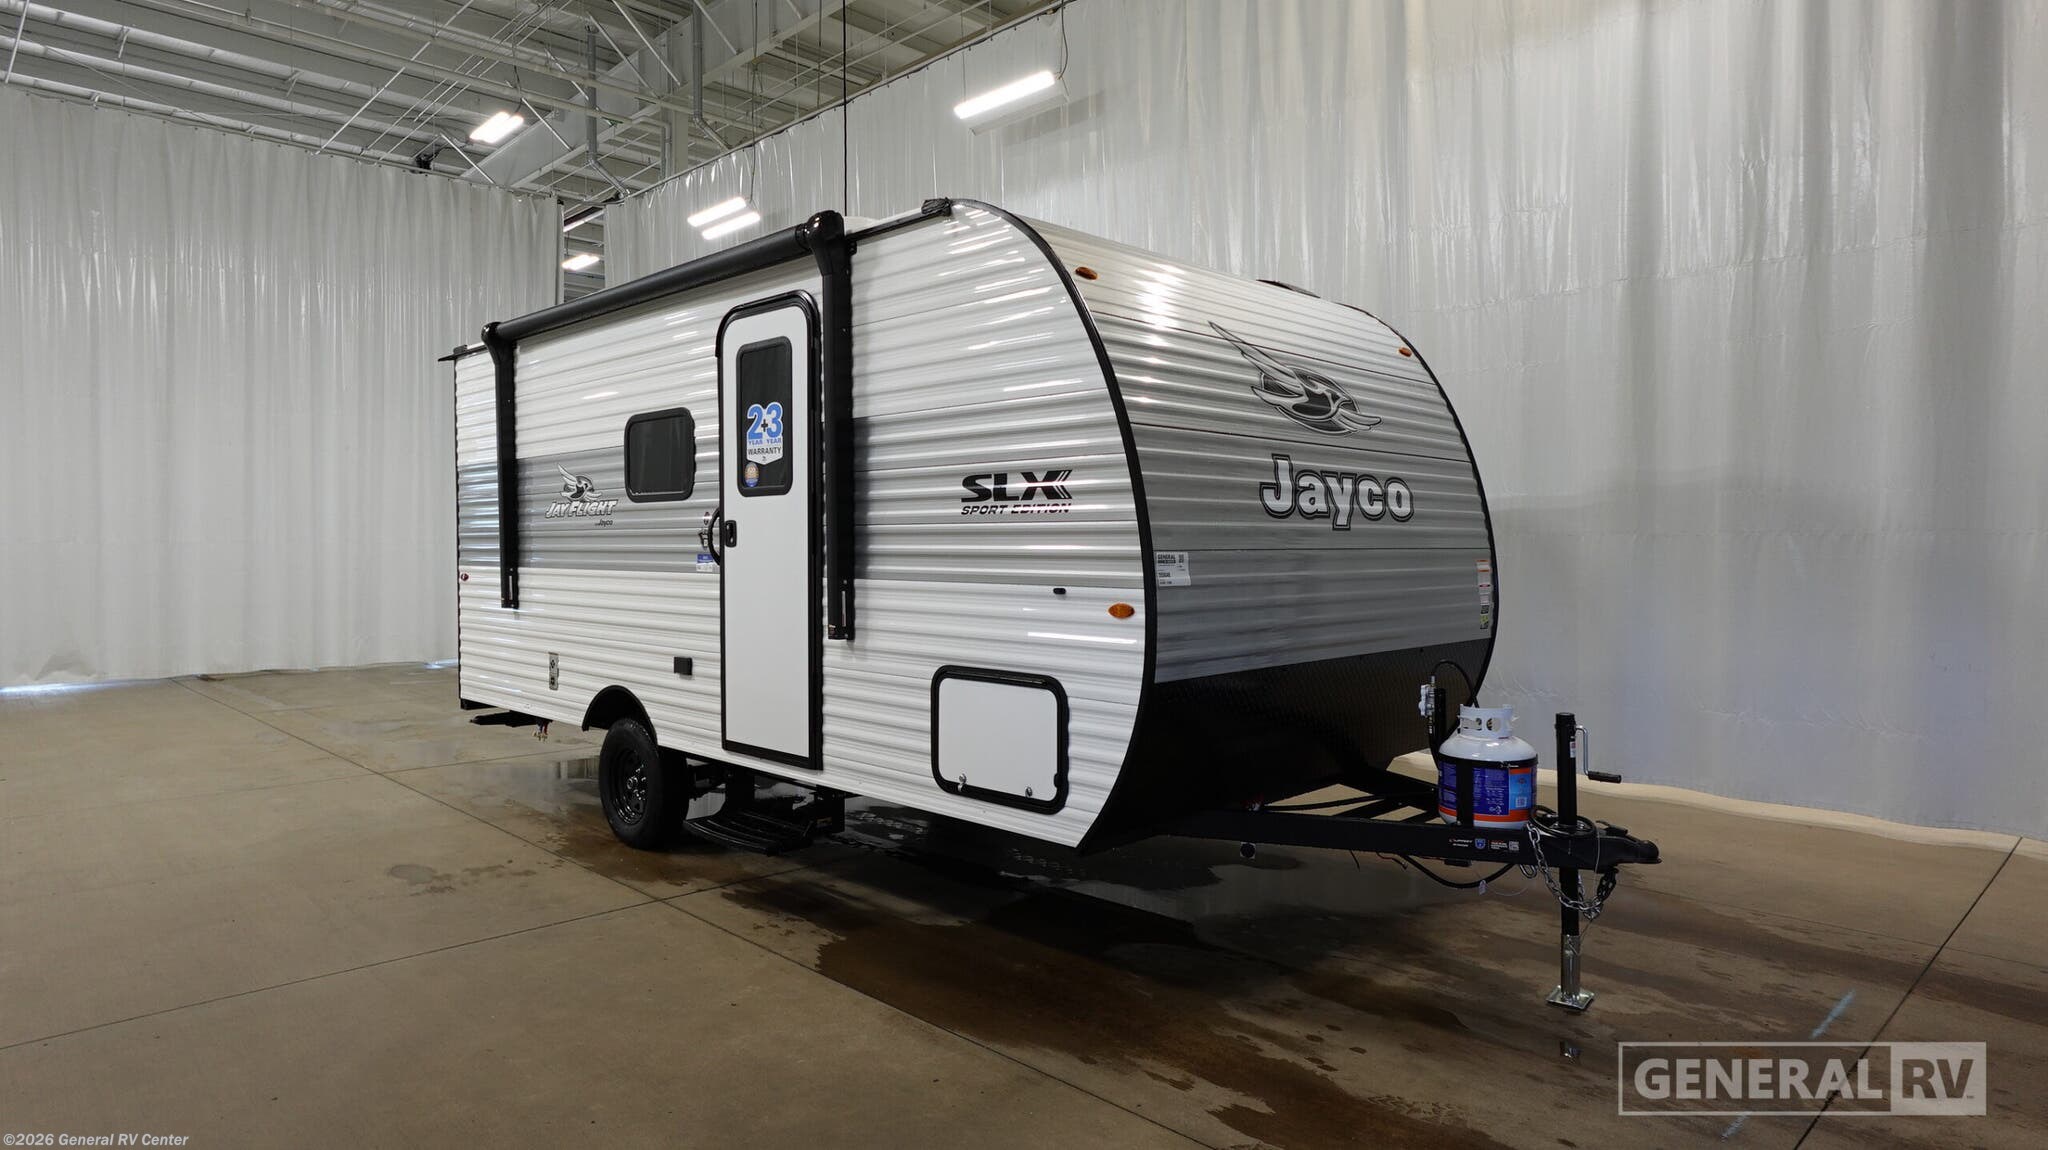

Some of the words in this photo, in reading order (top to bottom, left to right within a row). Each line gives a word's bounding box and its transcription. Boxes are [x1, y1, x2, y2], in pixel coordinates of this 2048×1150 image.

[747, 447, 782, 456] WARRANTY
[961, 470, 1073, 502] SLX
[1259, 453, 1414, 531] Jayco
[545, 501, 571, 518] JAY
[568, 499, 618, 517] FLIGHT
[961, 505, 1008, 515] SPORT
[1011, 502, 1072, 514] EDITION
